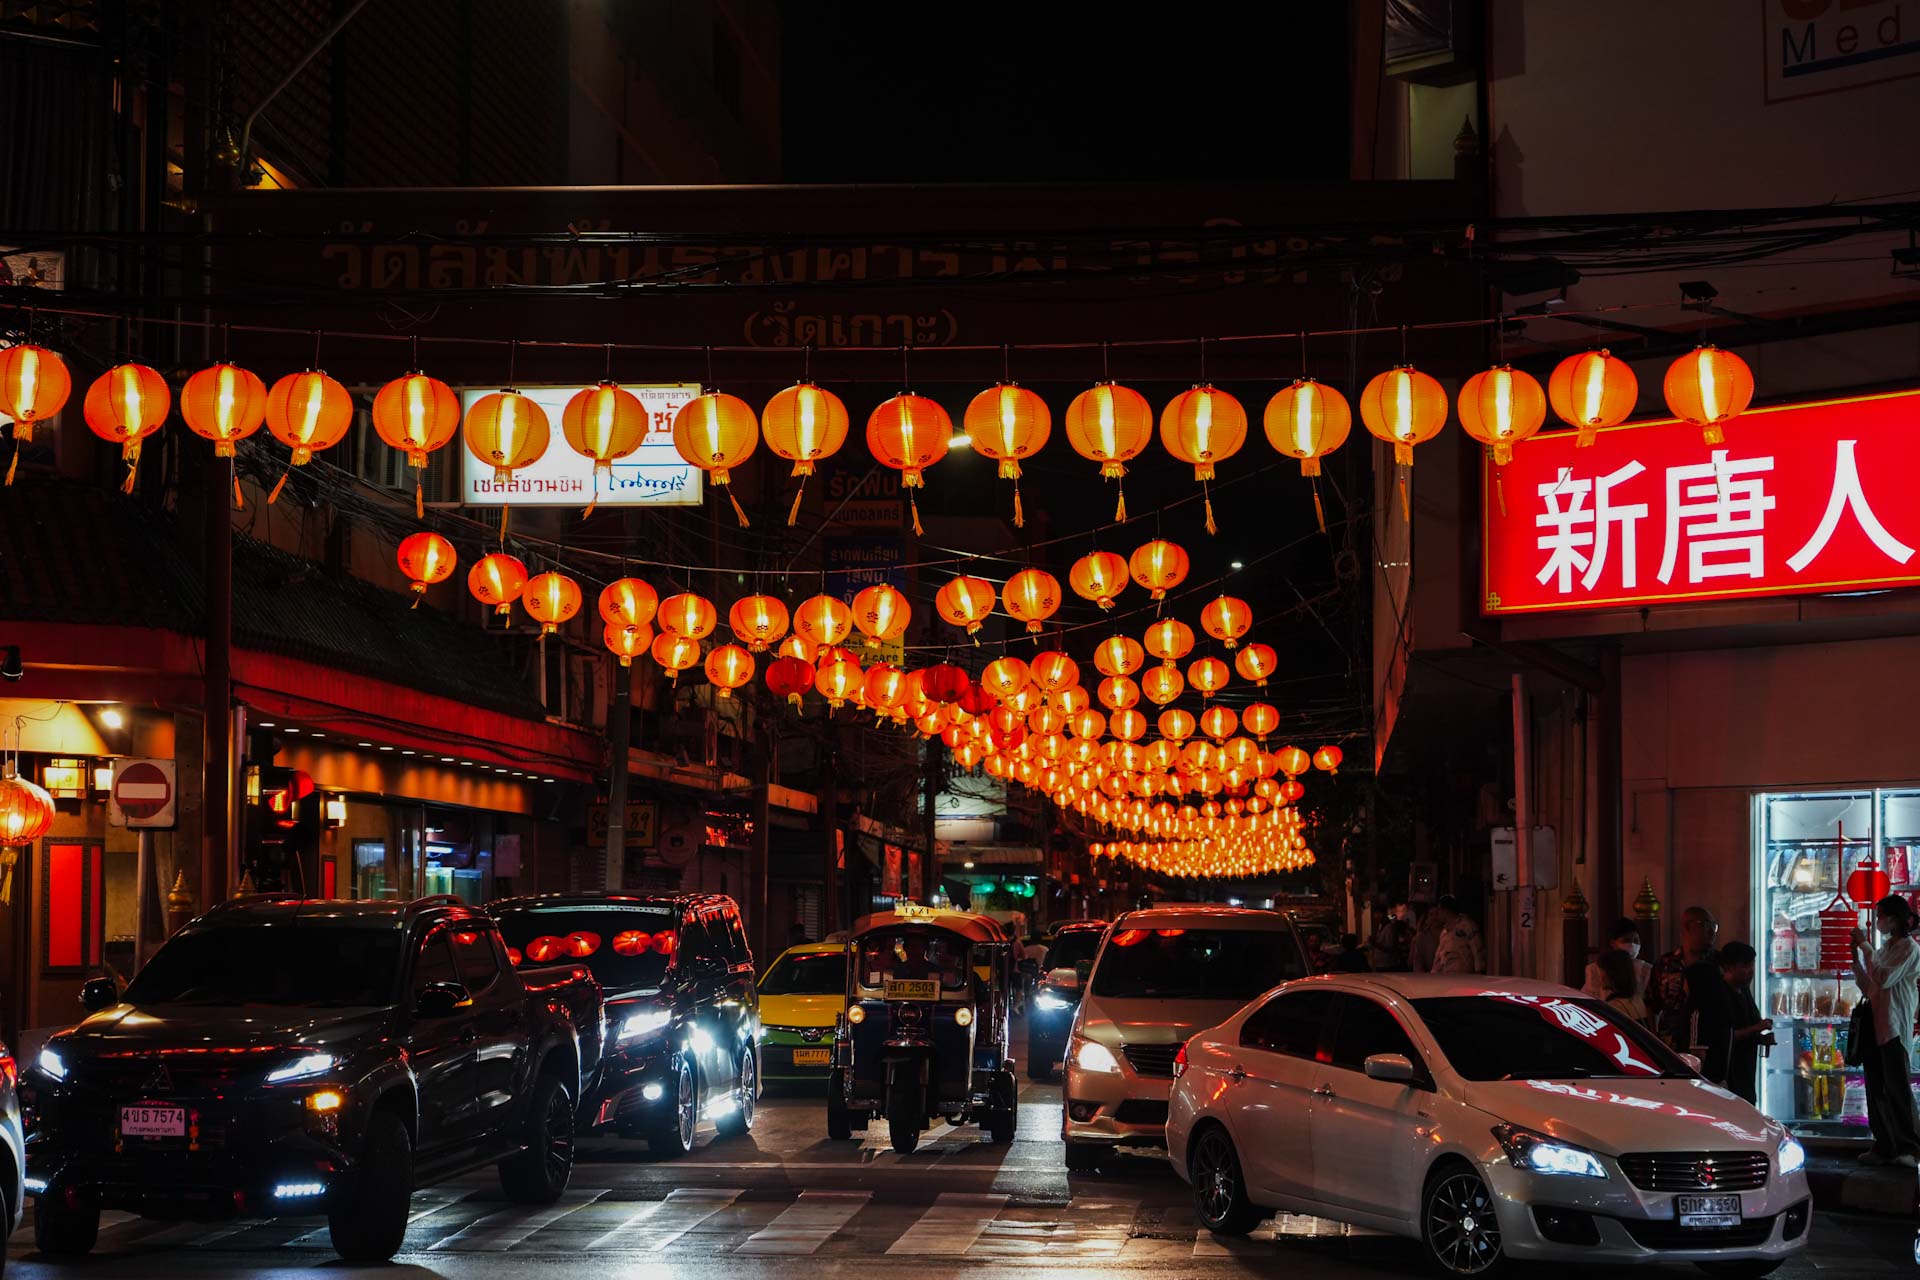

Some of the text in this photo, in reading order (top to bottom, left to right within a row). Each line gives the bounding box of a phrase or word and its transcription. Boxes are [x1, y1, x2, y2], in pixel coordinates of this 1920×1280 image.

[743, 300, 959, 347] (วัดเกาะ)
[473, 473, 583, 493] เชลล์ชวนชิม
[1534, 438, 1917, 594] 新唐人
[904, 907, 930, 915] TAXI
[1520, 912, 1532, 928] 2
[909, 982, 935, 992] 2503
[153, 1110, 183, 1123] 7574
